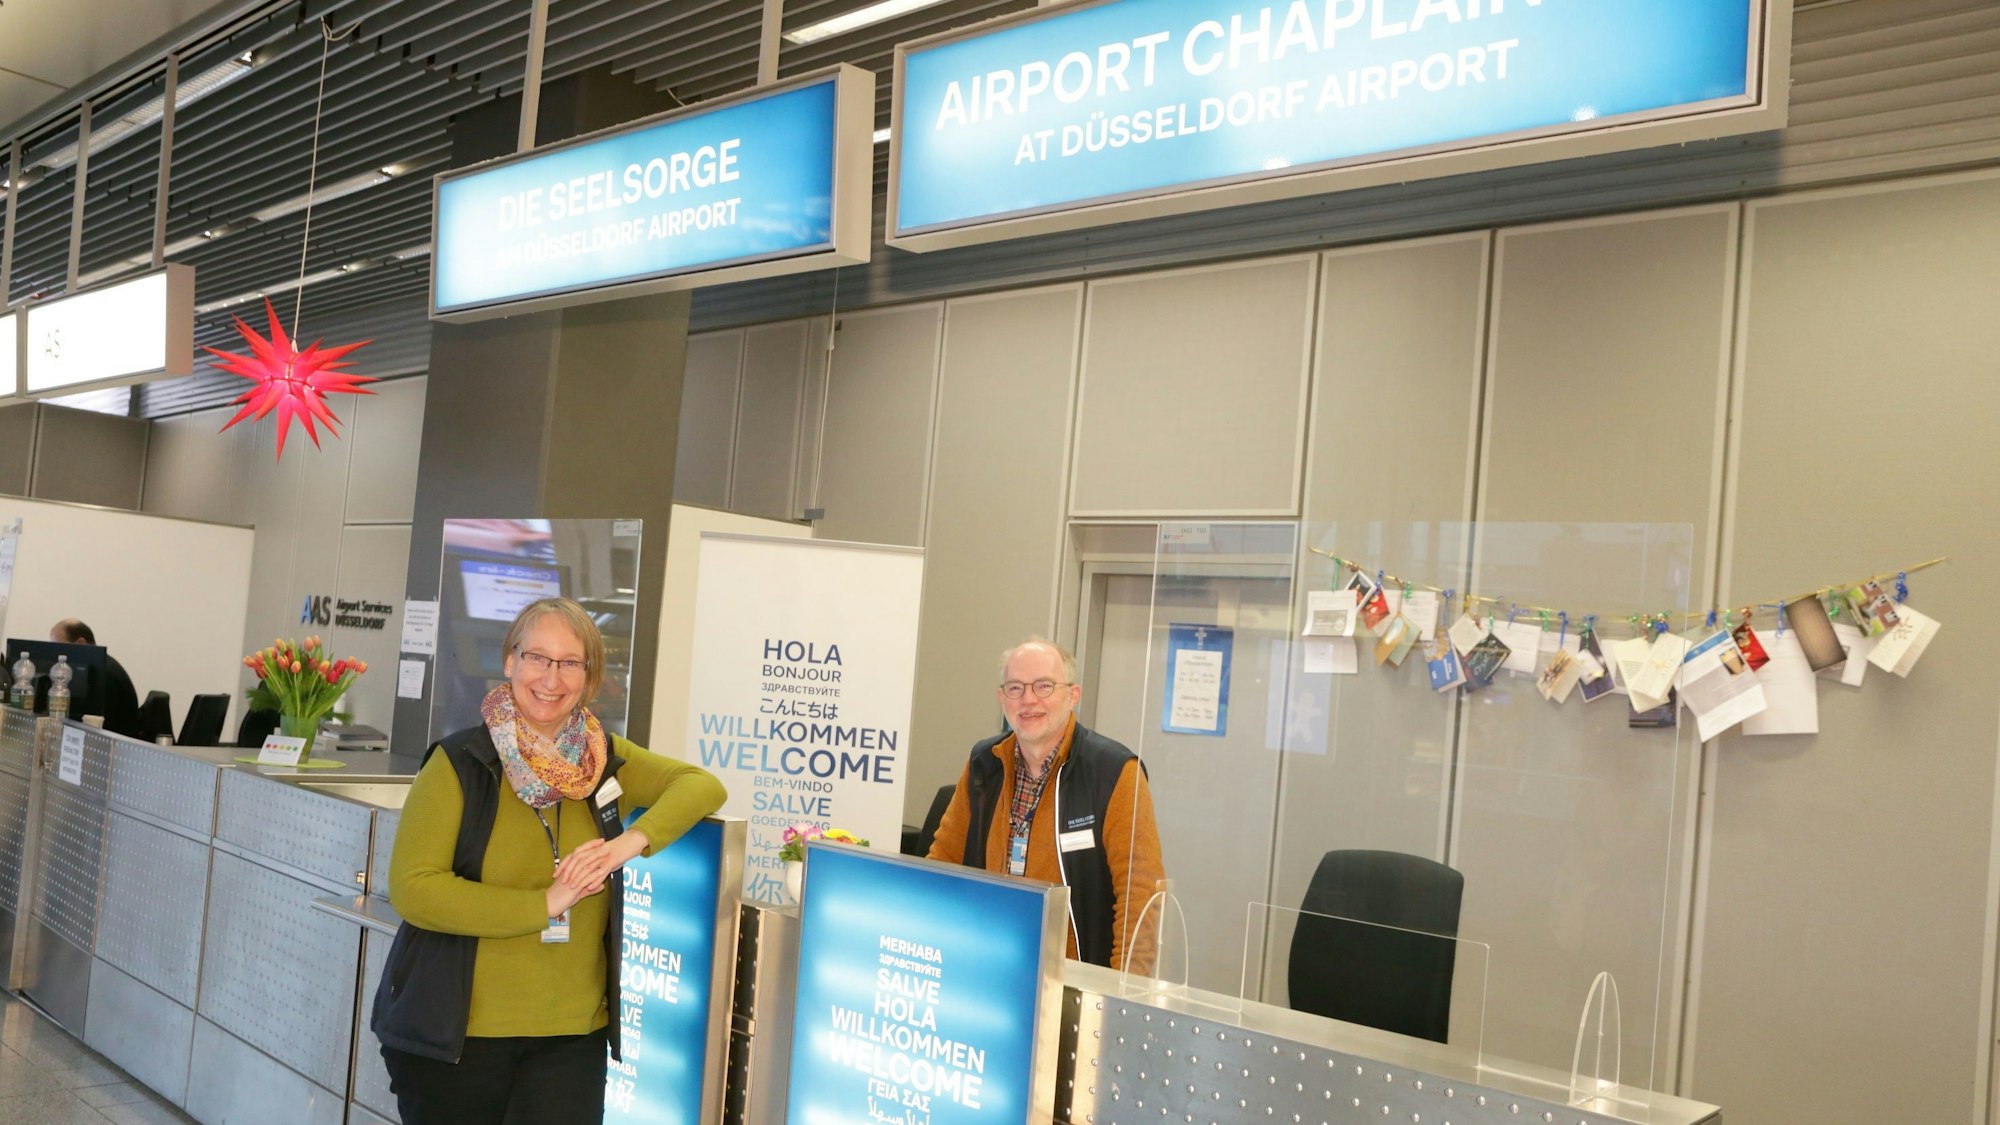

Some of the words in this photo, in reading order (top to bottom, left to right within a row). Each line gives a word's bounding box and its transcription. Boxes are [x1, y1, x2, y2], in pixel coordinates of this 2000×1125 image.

[936, 31, 1169, 131] AIRPORT
[1015, 129, 1056, 166] AT
[1061, 79, 1308, 158] DÜSSELDORF
[1317, 38, 1520, 113] AIRPORT
[498, 188, 543, 232] DIE
[551, 138, 740, 219] SEELSORGE
[524, 218, 645, 264] DÜSSELDORF
[648, 197, 741, 241] AIRPORT
[301, 593, 332, 627] AAS
[336, 598, 360, 613] Airport
[361, 600, 393, 615] Services
[763, 638, 842, 666] HOLA
[761, 683, 841, 698] ЗДРАВСТВУЙТЕ
[762, 664, 842, 683] BONJOUR
[760, 698, 839, 720] こんにちは
[700, 713, 897, 751] WILLKOMMEN
[698, 739, 896, 784] WELCOME
[753, 775, 833, 793] BEM-VINDO
[752, 792, 832, 817] SALVE
[611, 867, 653, 893] OLA
[747, 872, 797, 905] 你
[622, 938, 681, 974] OMMEN
[878, 954, 942, 978] ЗДРАВСТВУЙТЕ
[879, 935, 943, 963] MERHABA
[619, 960, 678, 1004] COME
[876, 968, 941, 1005] SALVE
[873, 991, 937, 1032] HOLA
[830, 1005, 985, 1073] WILLKOMMEN
[607, 1056, 637, 1078] RHABA
[828, 1031, 983, 1110] WELCOME
[867, 1077, 899, 1103] ΓΕΙΑ
[902, 1088, 931, 1113] ΣΑΣ
